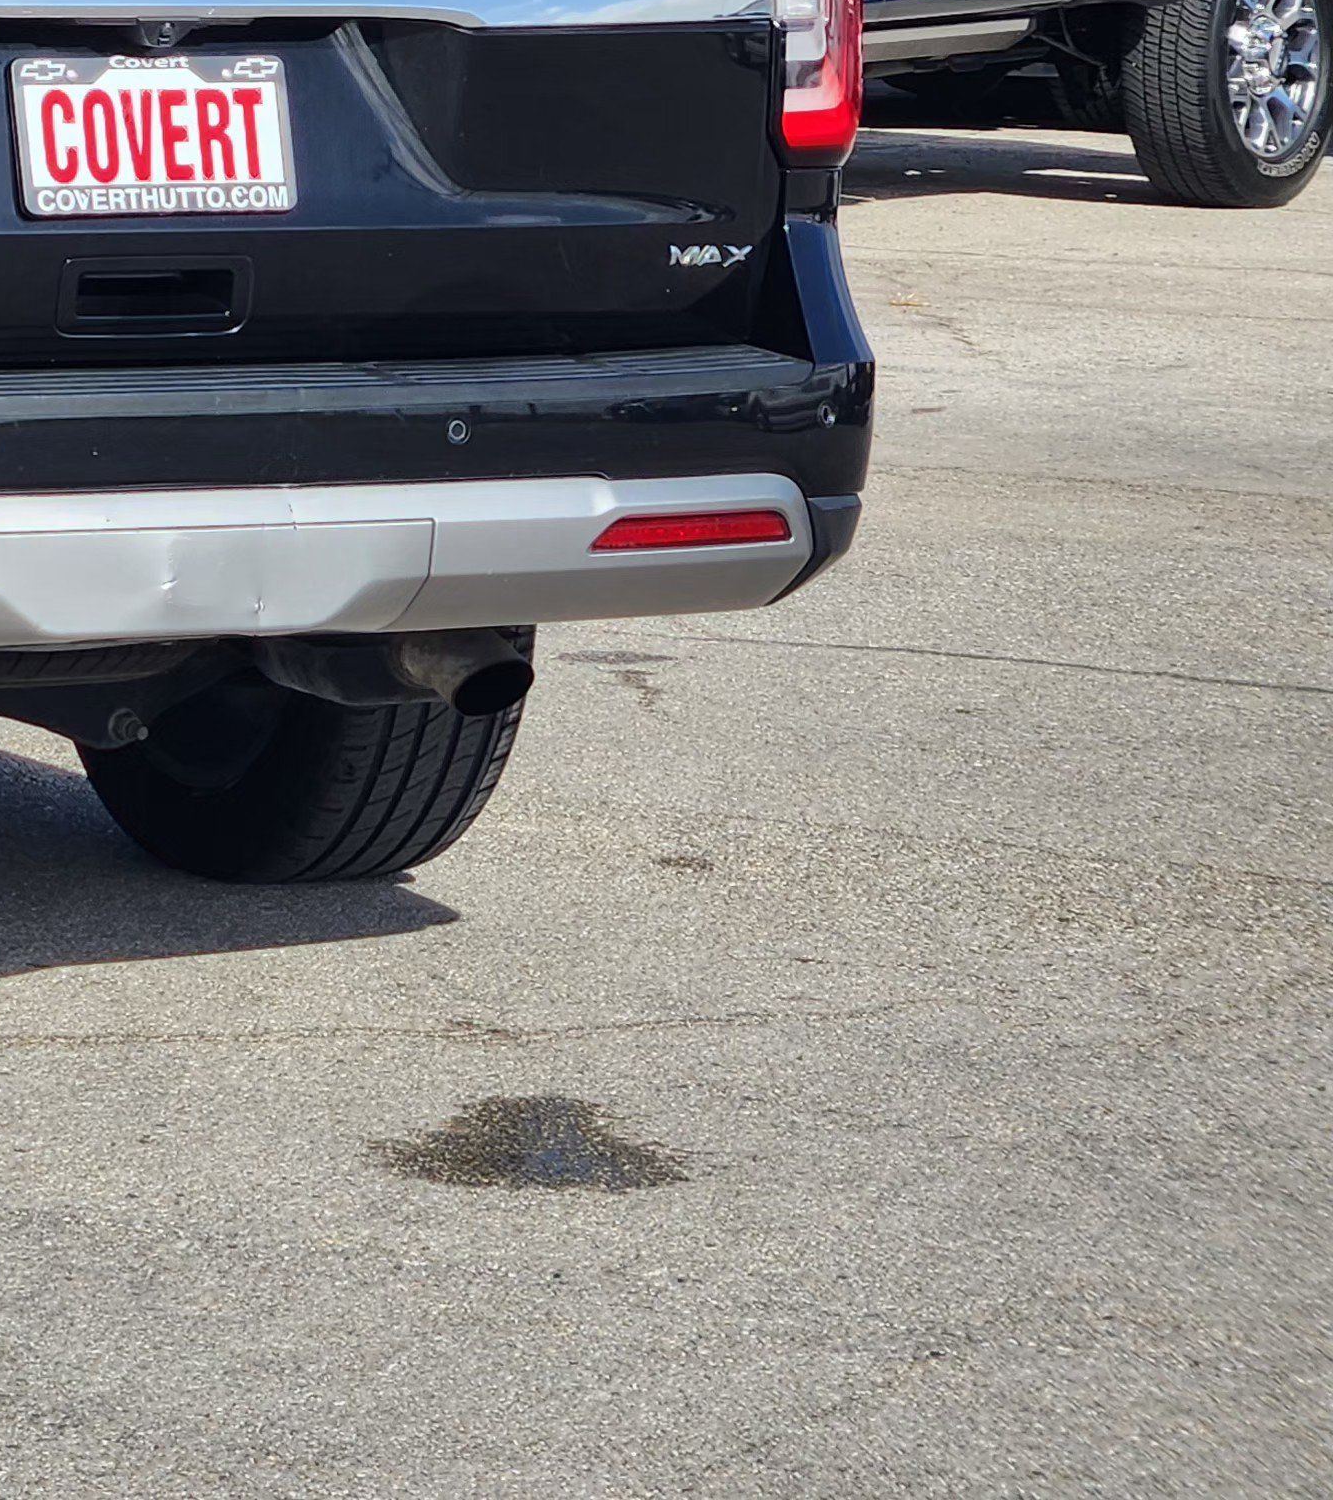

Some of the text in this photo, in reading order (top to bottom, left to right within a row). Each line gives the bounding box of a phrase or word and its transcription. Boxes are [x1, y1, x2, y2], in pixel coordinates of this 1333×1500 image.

[108, 55, 189, 69] Covert
[41, 88, 264, 184] COVERT
[37, 186, 289, 212] COVERTHUTTO.COM
[669, 244, 753, 268] MAX
